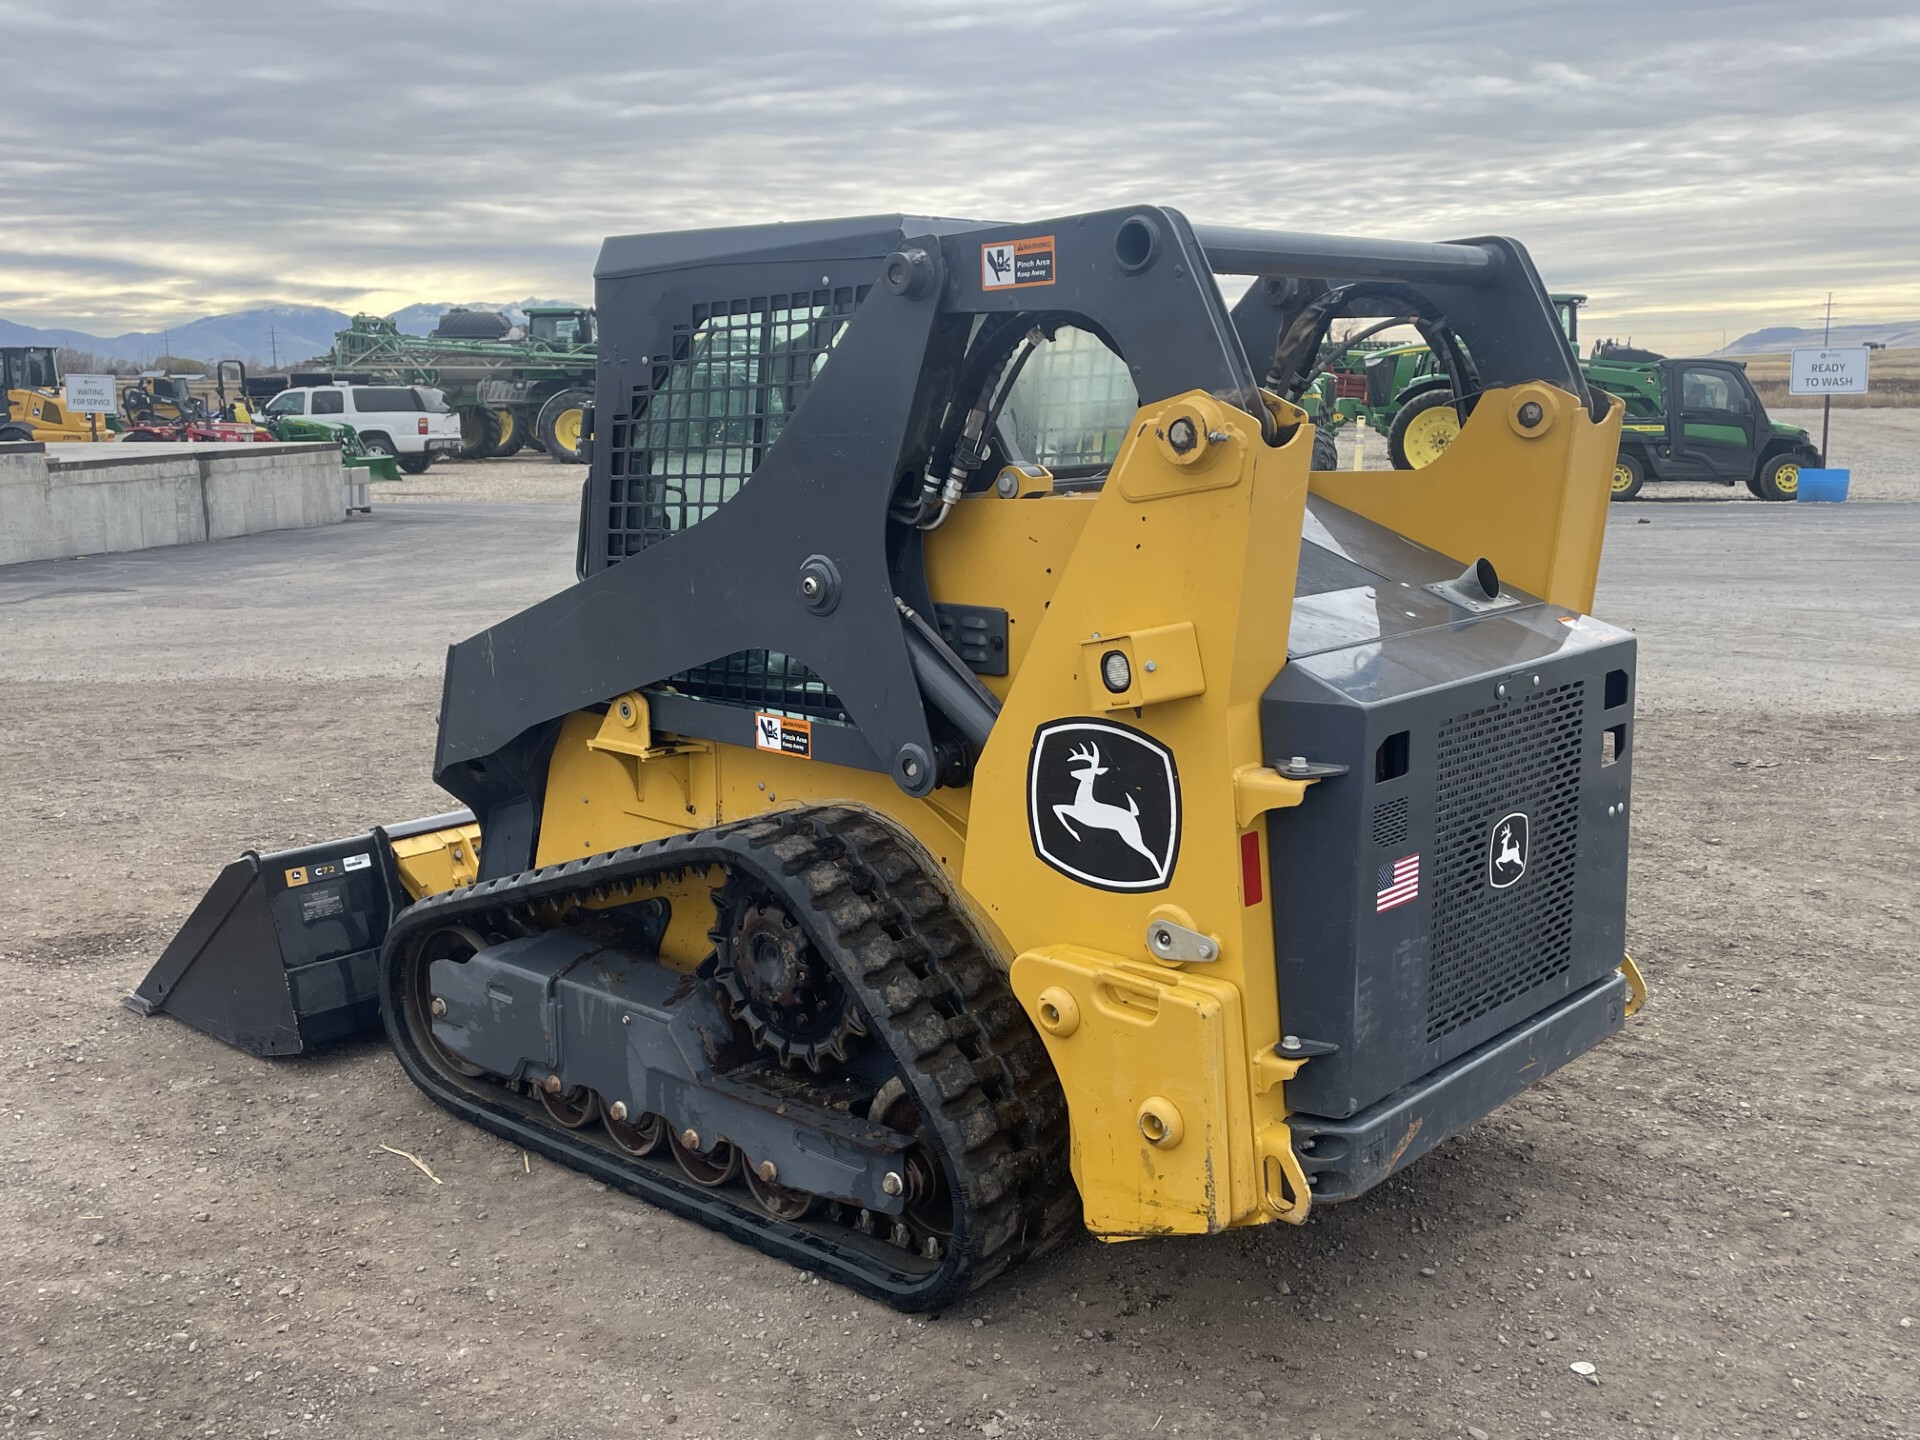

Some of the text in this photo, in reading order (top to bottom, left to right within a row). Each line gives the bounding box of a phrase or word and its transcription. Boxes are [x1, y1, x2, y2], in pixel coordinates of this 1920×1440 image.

[1023, 241, 1051, 250] WARNING
[1017, 258, 1050, 268] Pinch Area
[1017, 269, 1046, 278] Keep Away
[1811, 363, 1846, 373] READY
[1805, 376, 1853, 387] TO WASH
[77, 388, 104, 396] WAITING
[73, 398, 111, 406] FOR SERVICE
[782, 732, 807, 743] Pinch Area
[792, 743, 804, 751] Away
[315, 865, 335, 876] C72
